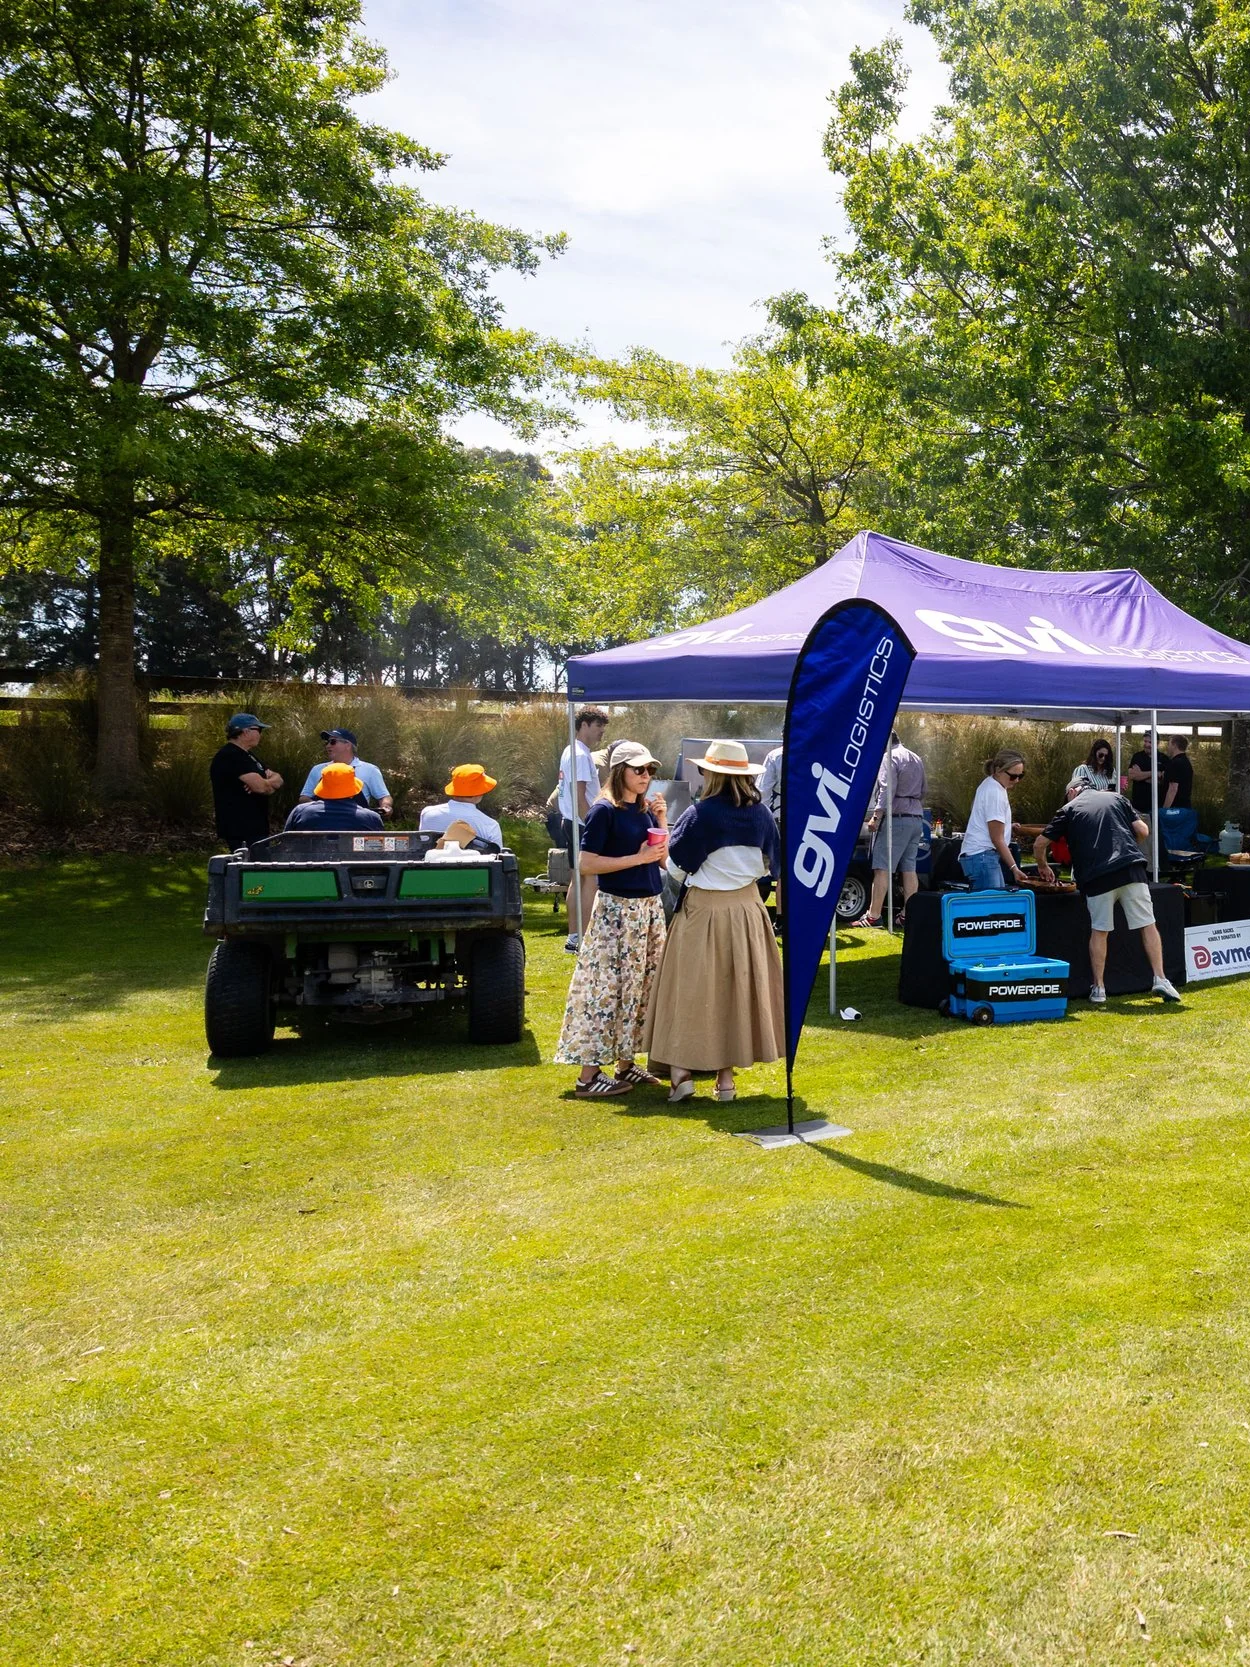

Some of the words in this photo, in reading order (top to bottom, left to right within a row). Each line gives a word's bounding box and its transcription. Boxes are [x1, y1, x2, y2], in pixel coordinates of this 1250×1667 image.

[914, 609, 1101, 655] gvi
[1088, 643, 1250, 665] LOGISTICS
[793, 762, 851, 898] gvi
[838, 636, 894, 784] LOGISTICS
